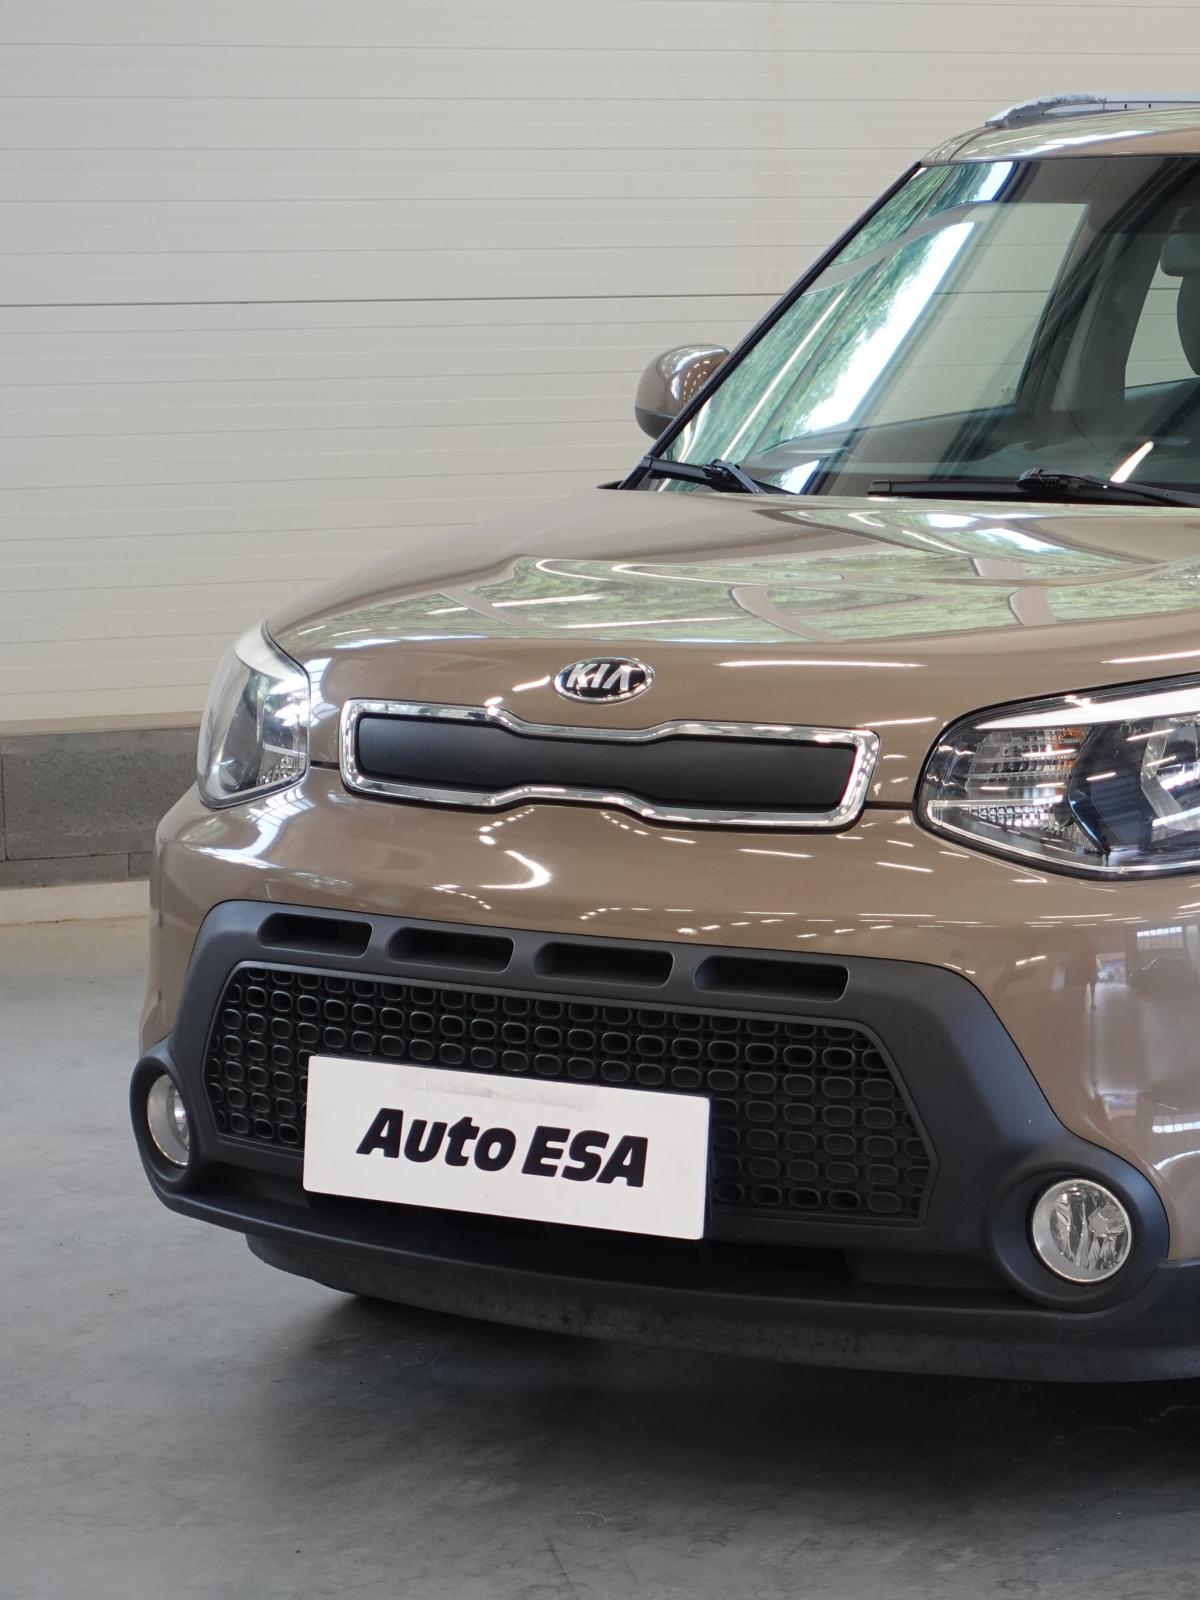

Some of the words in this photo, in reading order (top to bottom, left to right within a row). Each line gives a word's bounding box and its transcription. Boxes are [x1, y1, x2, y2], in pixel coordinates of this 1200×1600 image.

[565, 663, 632, 691] KIA
[356, 1107, 516, 1172] Auto
[521, 1125, 649, 1188] ESA
